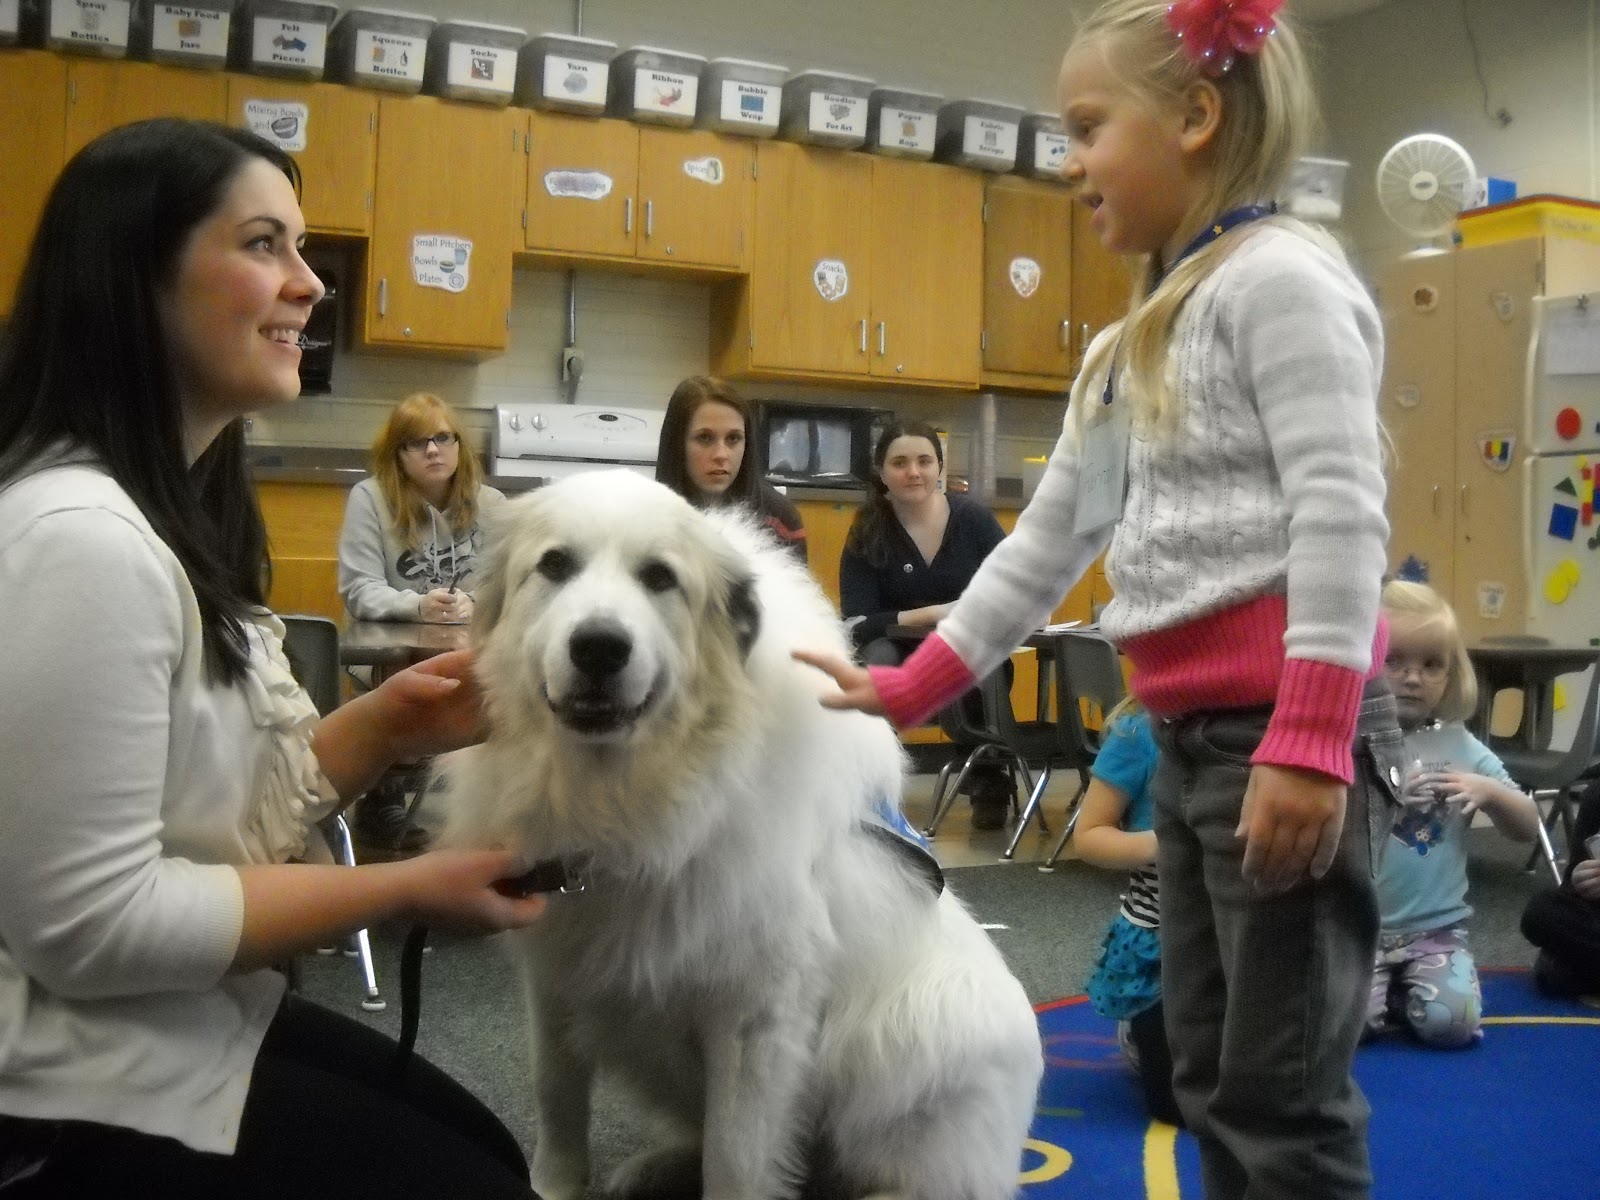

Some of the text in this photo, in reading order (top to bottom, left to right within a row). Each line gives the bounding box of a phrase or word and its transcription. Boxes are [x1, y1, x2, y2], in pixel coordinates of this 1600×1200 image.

[165, 7, 220, 20] Baby Food
[281, 23, 300, 32] Felt
[70, 31, 110, 42] Bottles
[372, 35, 413, 47] Squeeze
[180, 40, 200, 49] Jars
[272, 53, 306, 63] Pieces
[470, 48, 498, 59] Socks
[372, 65, 408, 76] Bottles
[567, 62, 588, 72] Yarn
[651, 73, 684, 85] Ribbon
[738, 85, 768, 95] Bubble
[823, 95, 857, 105] Noodles
[247, 104, 304, 117] Mixing Bowls
[740, 111, 763, 121] Wrap
[898, 111, 922, 121] Paper
[255, 120, 270, 130] and
[825, 122, 853, 131] For Art
[416, 237, 471, 249] Small Pitchers
[414, 256, 438, 266] Bowls
[822, 262, 844, 274] Snacks
[1015, 262, 1036, 271] Snacks
[419, 272, 442, 283] Plates
